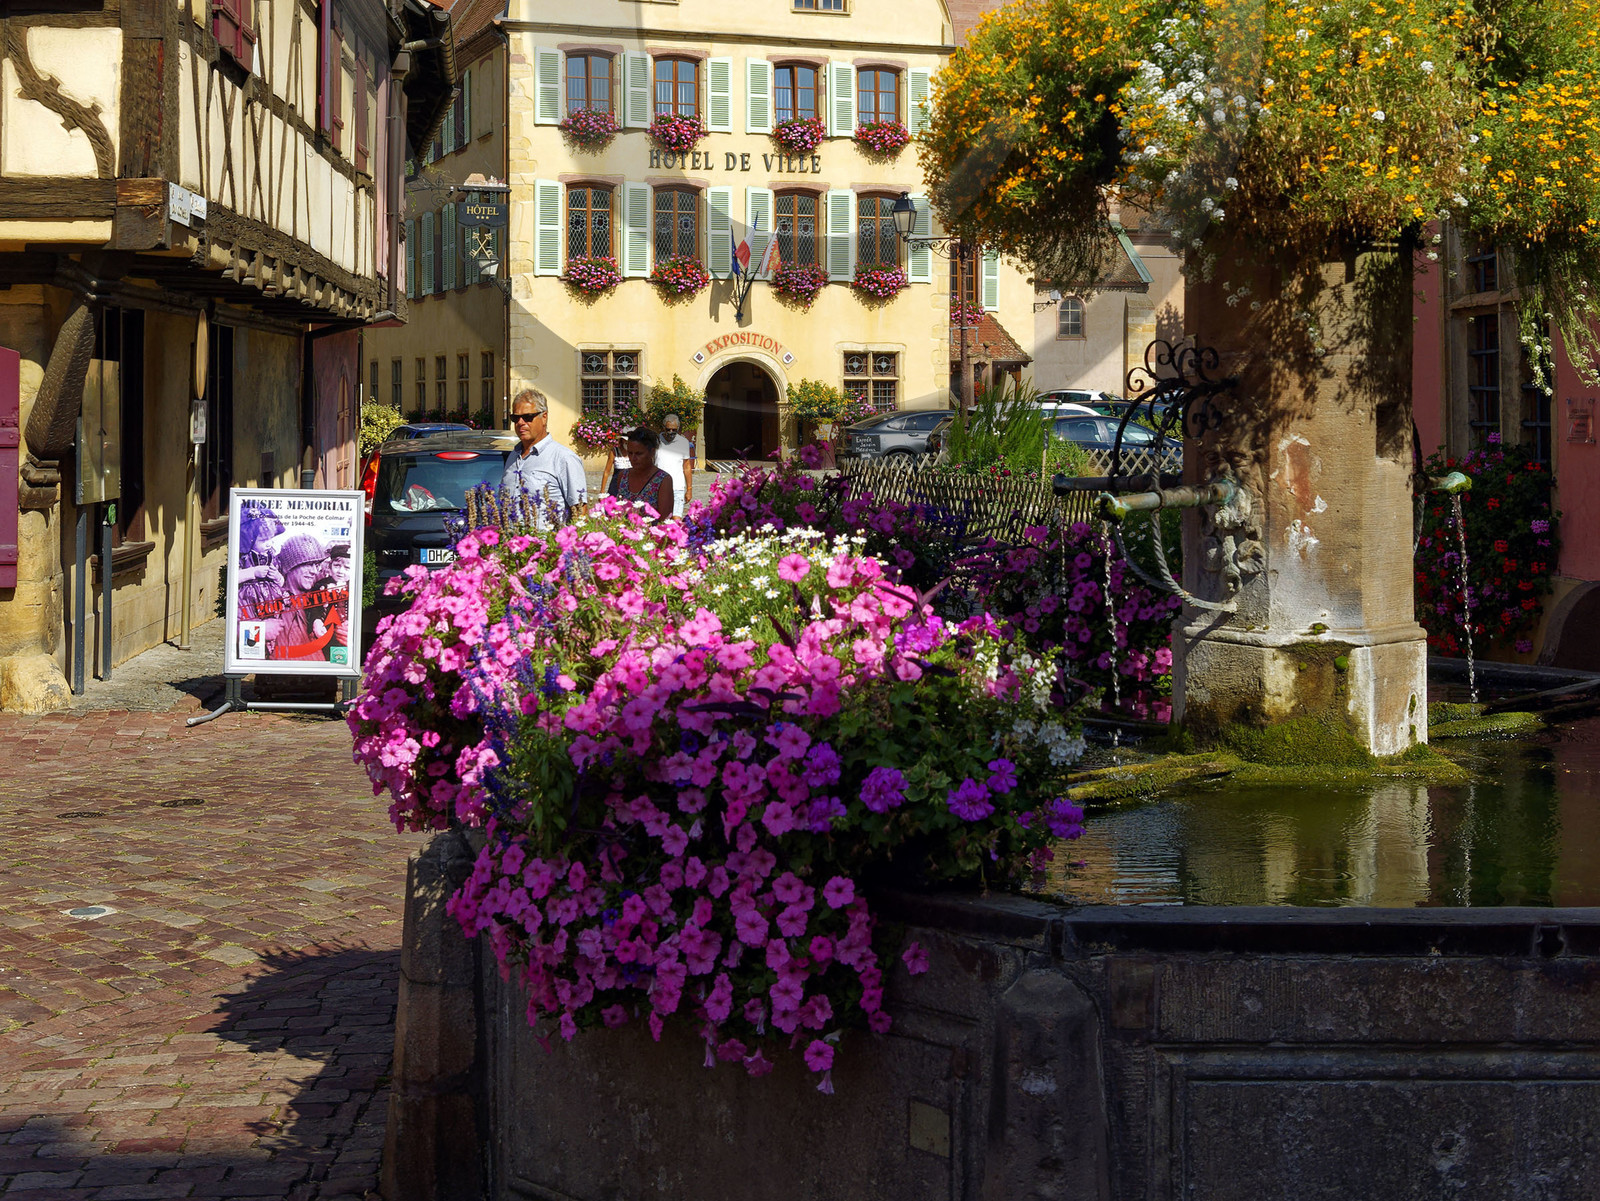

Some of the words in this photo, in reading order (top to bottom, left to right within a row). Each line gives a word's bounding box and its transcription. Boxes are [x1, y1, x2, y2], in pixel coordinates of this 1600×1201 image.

[724, 151, 751, 172] DE
[762, 153, 822, 174] VILLE
[466, 203, 500, 216] HÔTEL
[705, 331, 783, 355] EXPOSITION
[241, 499, 283, 510] MUSEE
[286, 500, 353, 511] MEMORIAL
[255, 600, 284, 616] 200
